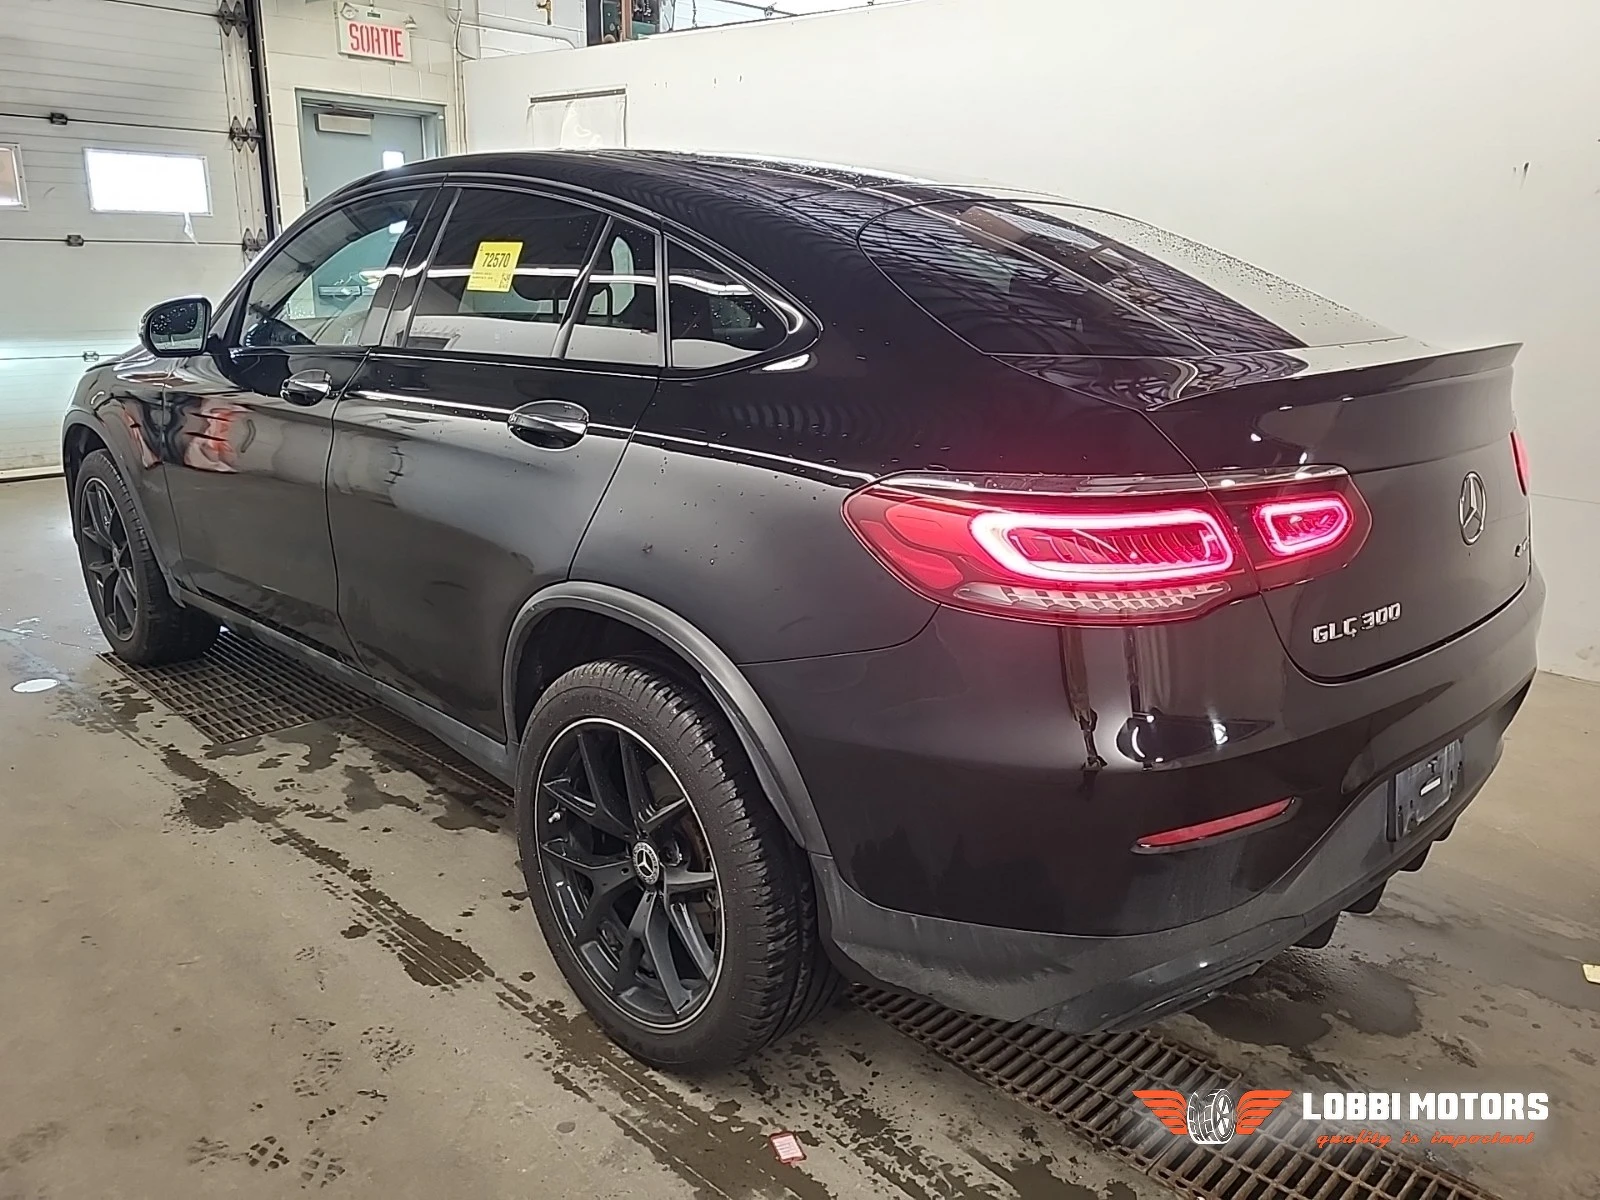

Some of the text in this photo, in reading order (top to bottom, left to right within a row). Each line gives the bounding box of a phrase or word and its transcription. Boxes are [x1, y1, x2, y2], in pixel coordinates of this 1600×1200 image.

[349, 23, 404, 58] SORTIE
[482, 252, 511, 268] 72570
[1312, 602, 1401, 644] GLC 300
